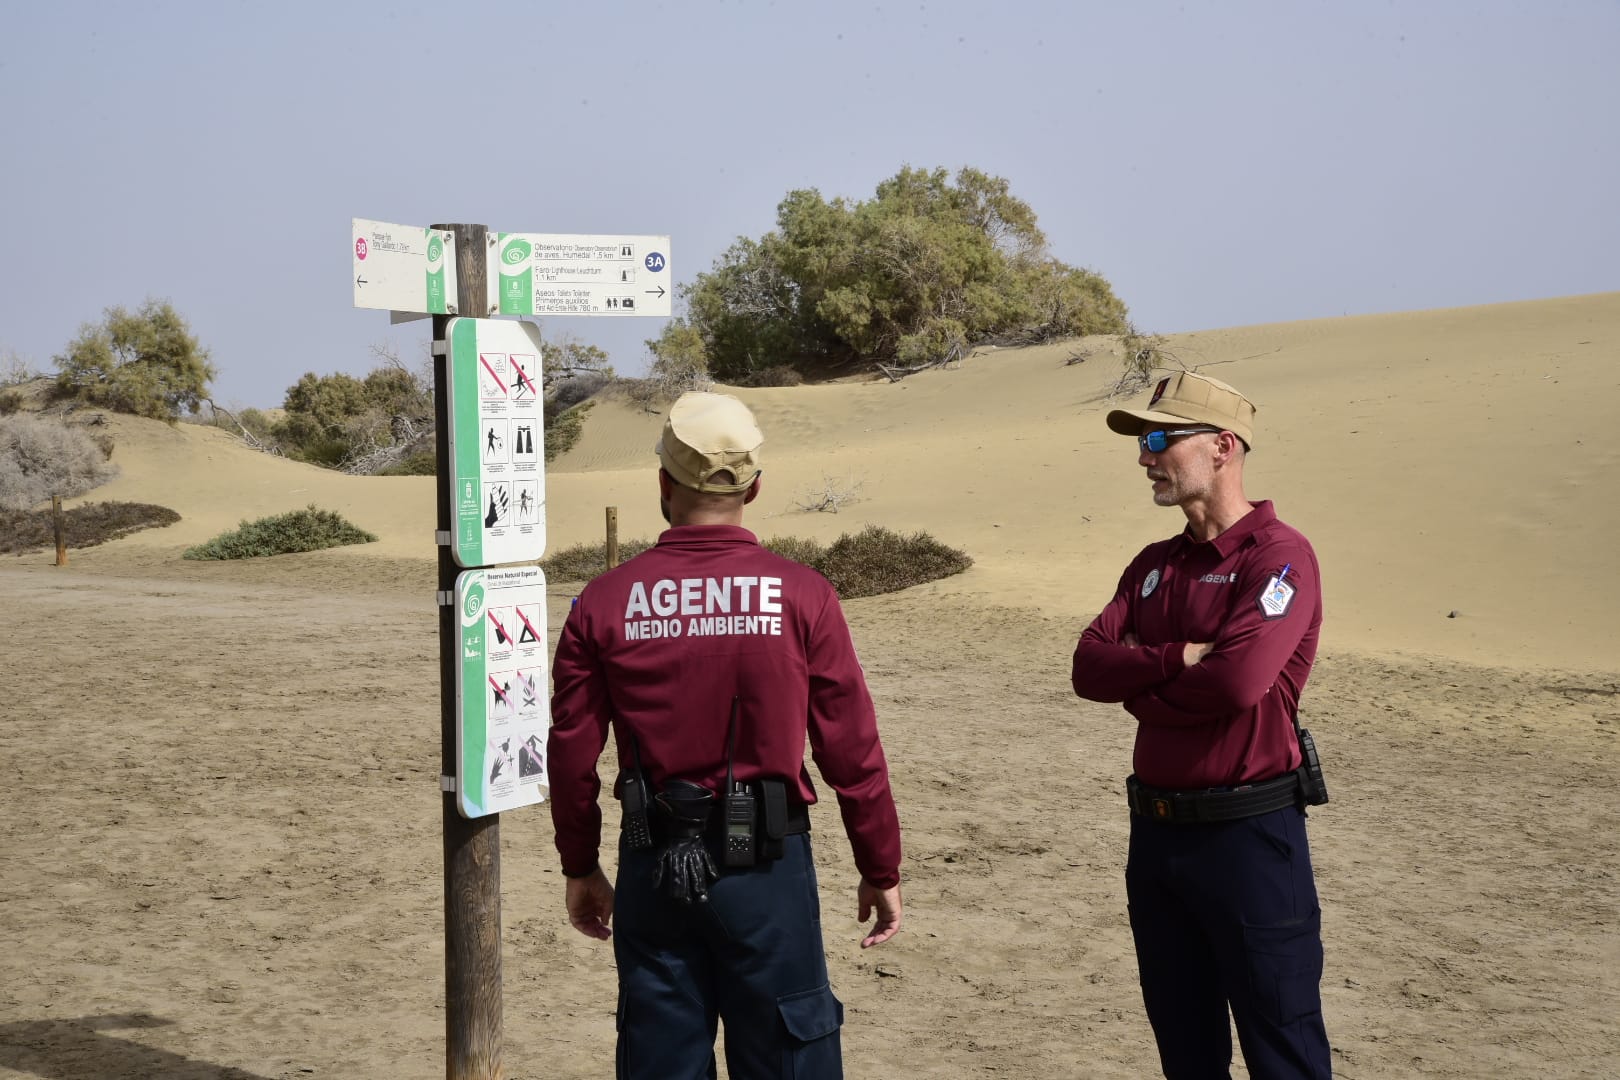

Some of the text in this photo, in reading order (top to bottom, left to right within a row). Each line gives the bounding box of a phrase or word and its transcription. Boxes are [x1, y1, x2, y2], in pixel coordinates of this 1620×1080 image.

[357, 242, 366, 255] 3B
[534, 242, 573, 251] Observatorio
[562, 251, 591, 259] Humedal
[647, 256, 663, 267] 3A
[535, 266, 550, 274] Faro
[535, 289, 555, 297] Aseos
[535, 296, 589, 305] Primeros auxilios
[504, 571, 521, 579] Natural
[1199, 572, 1237, 584] AGENE
[625, 576, 782, 619] AGENTE
[625, 615, 782, 641] MEDIO AMBIENTE
